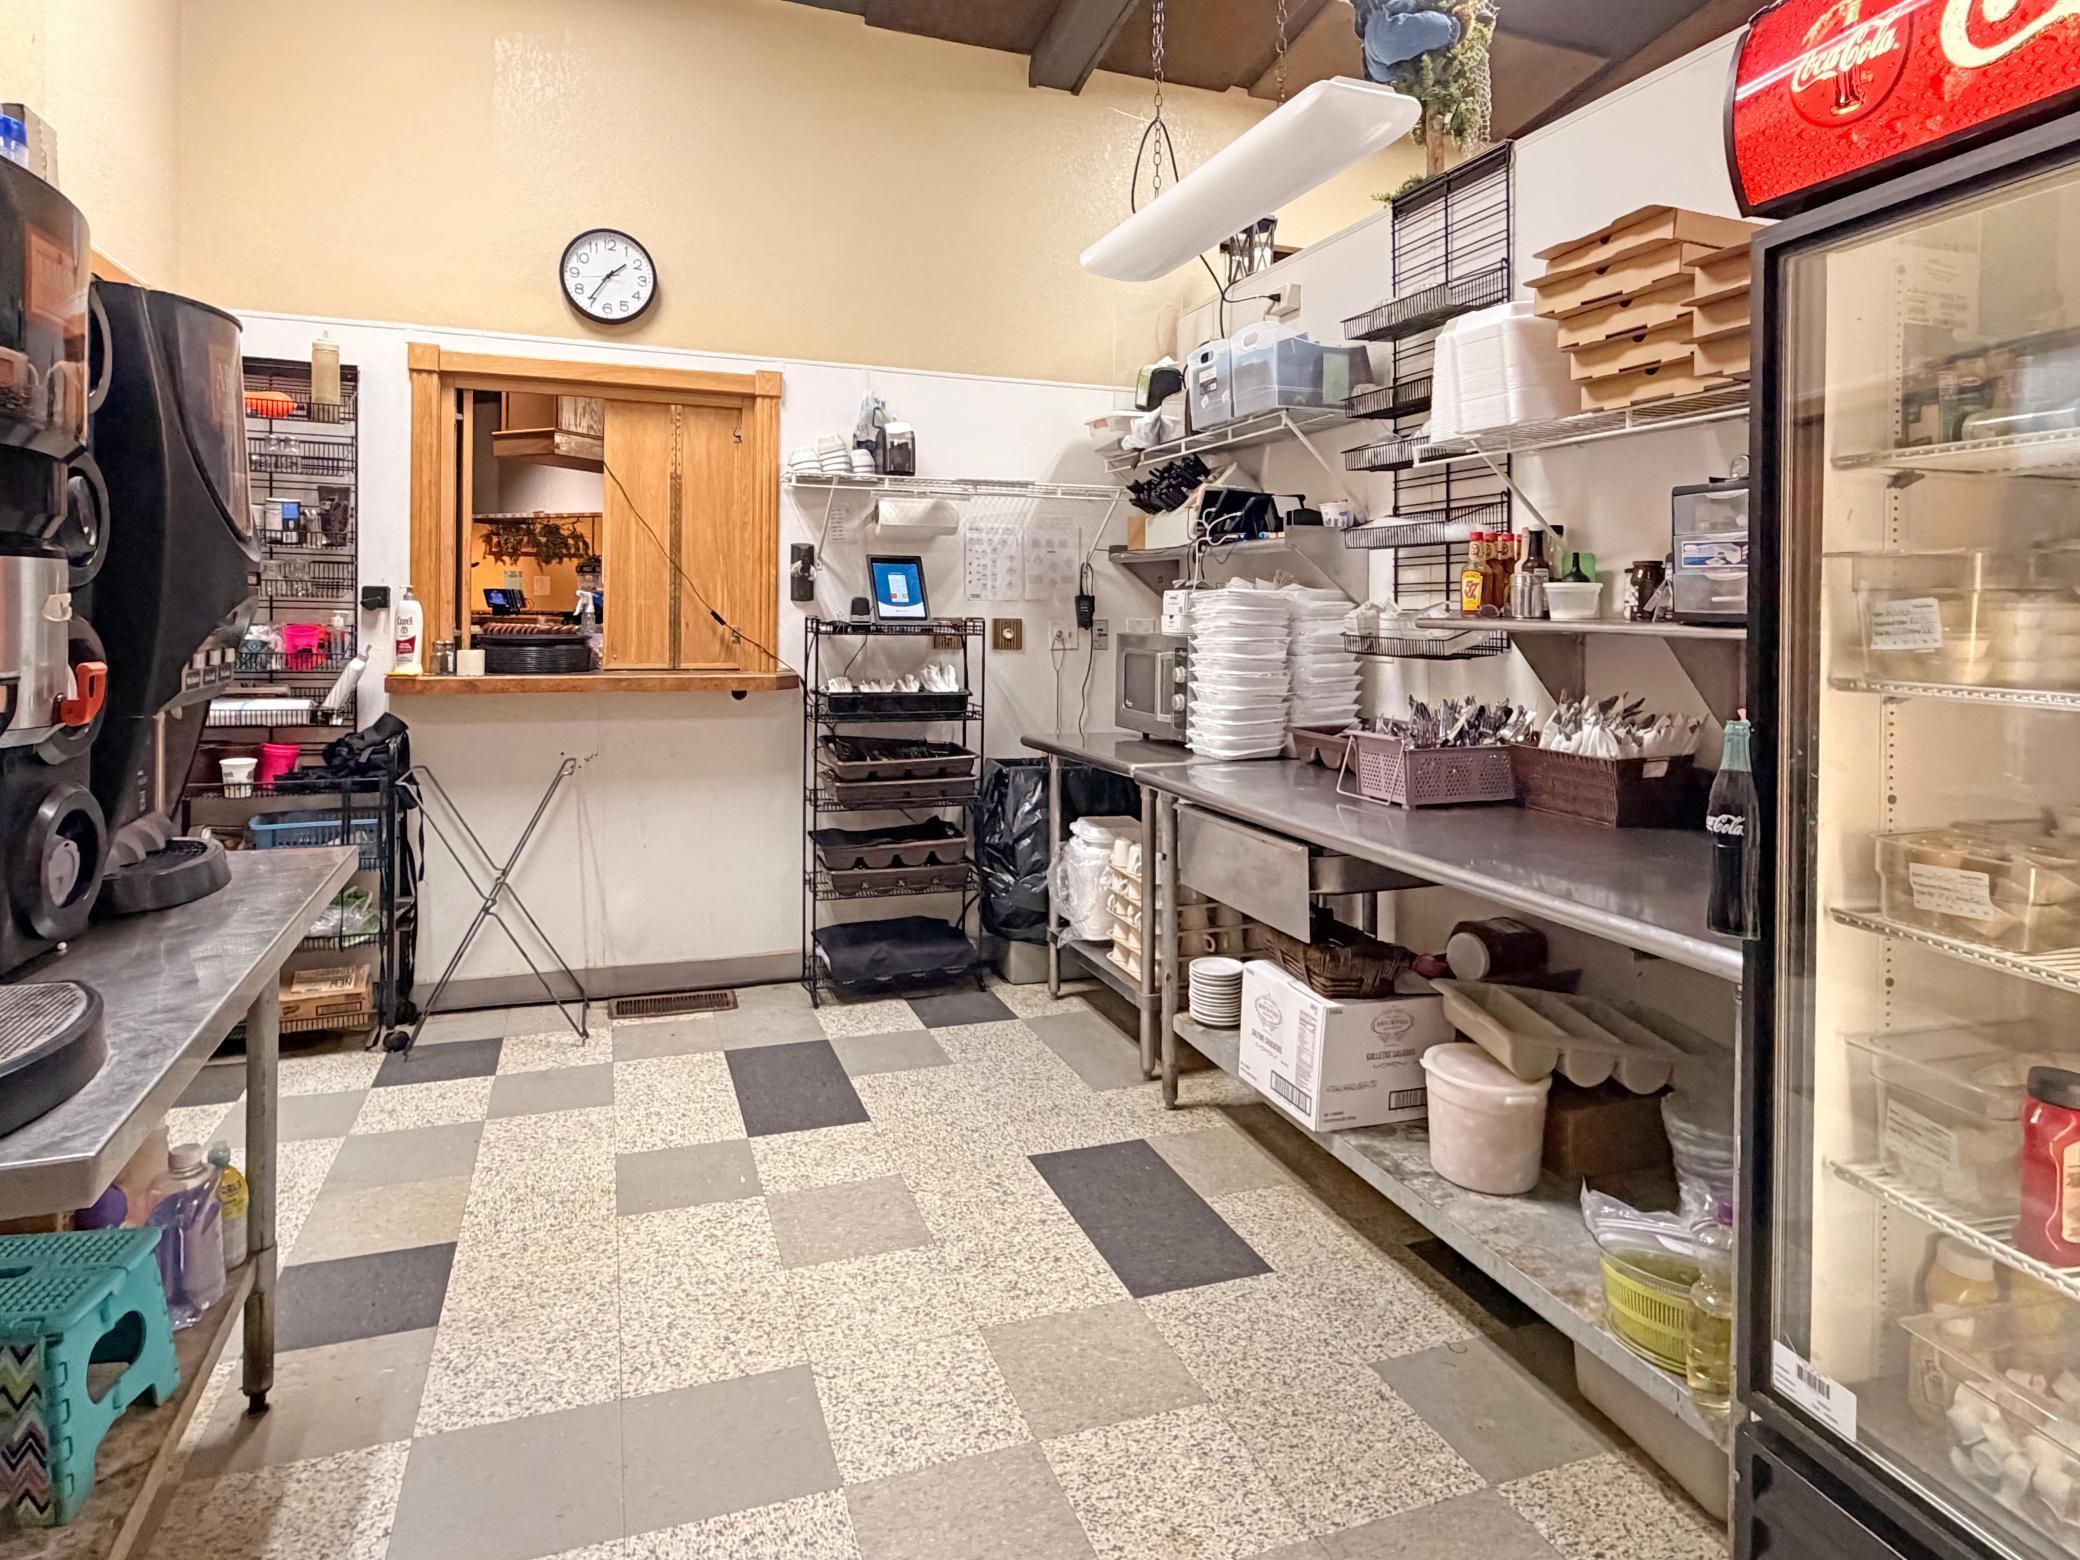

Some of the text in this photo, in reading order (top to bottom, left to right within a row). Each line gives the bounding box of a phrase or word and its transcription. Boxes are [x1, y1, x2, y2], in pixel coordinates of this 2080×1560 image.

[589, 241, 598, 254] 11
[604, 239, 617, 252] 12
[576, 252, 589, 264] 10
[633, 259, 643, 271] 2
[569, 267, 580, 278] 9
[637, 276, 647, 287] 3
[574, 283, 584, 295] 8
[632, 291, 641, 302] 4
[602, 303, 613, 314] 6
[619, 301, 629, 312] 5
